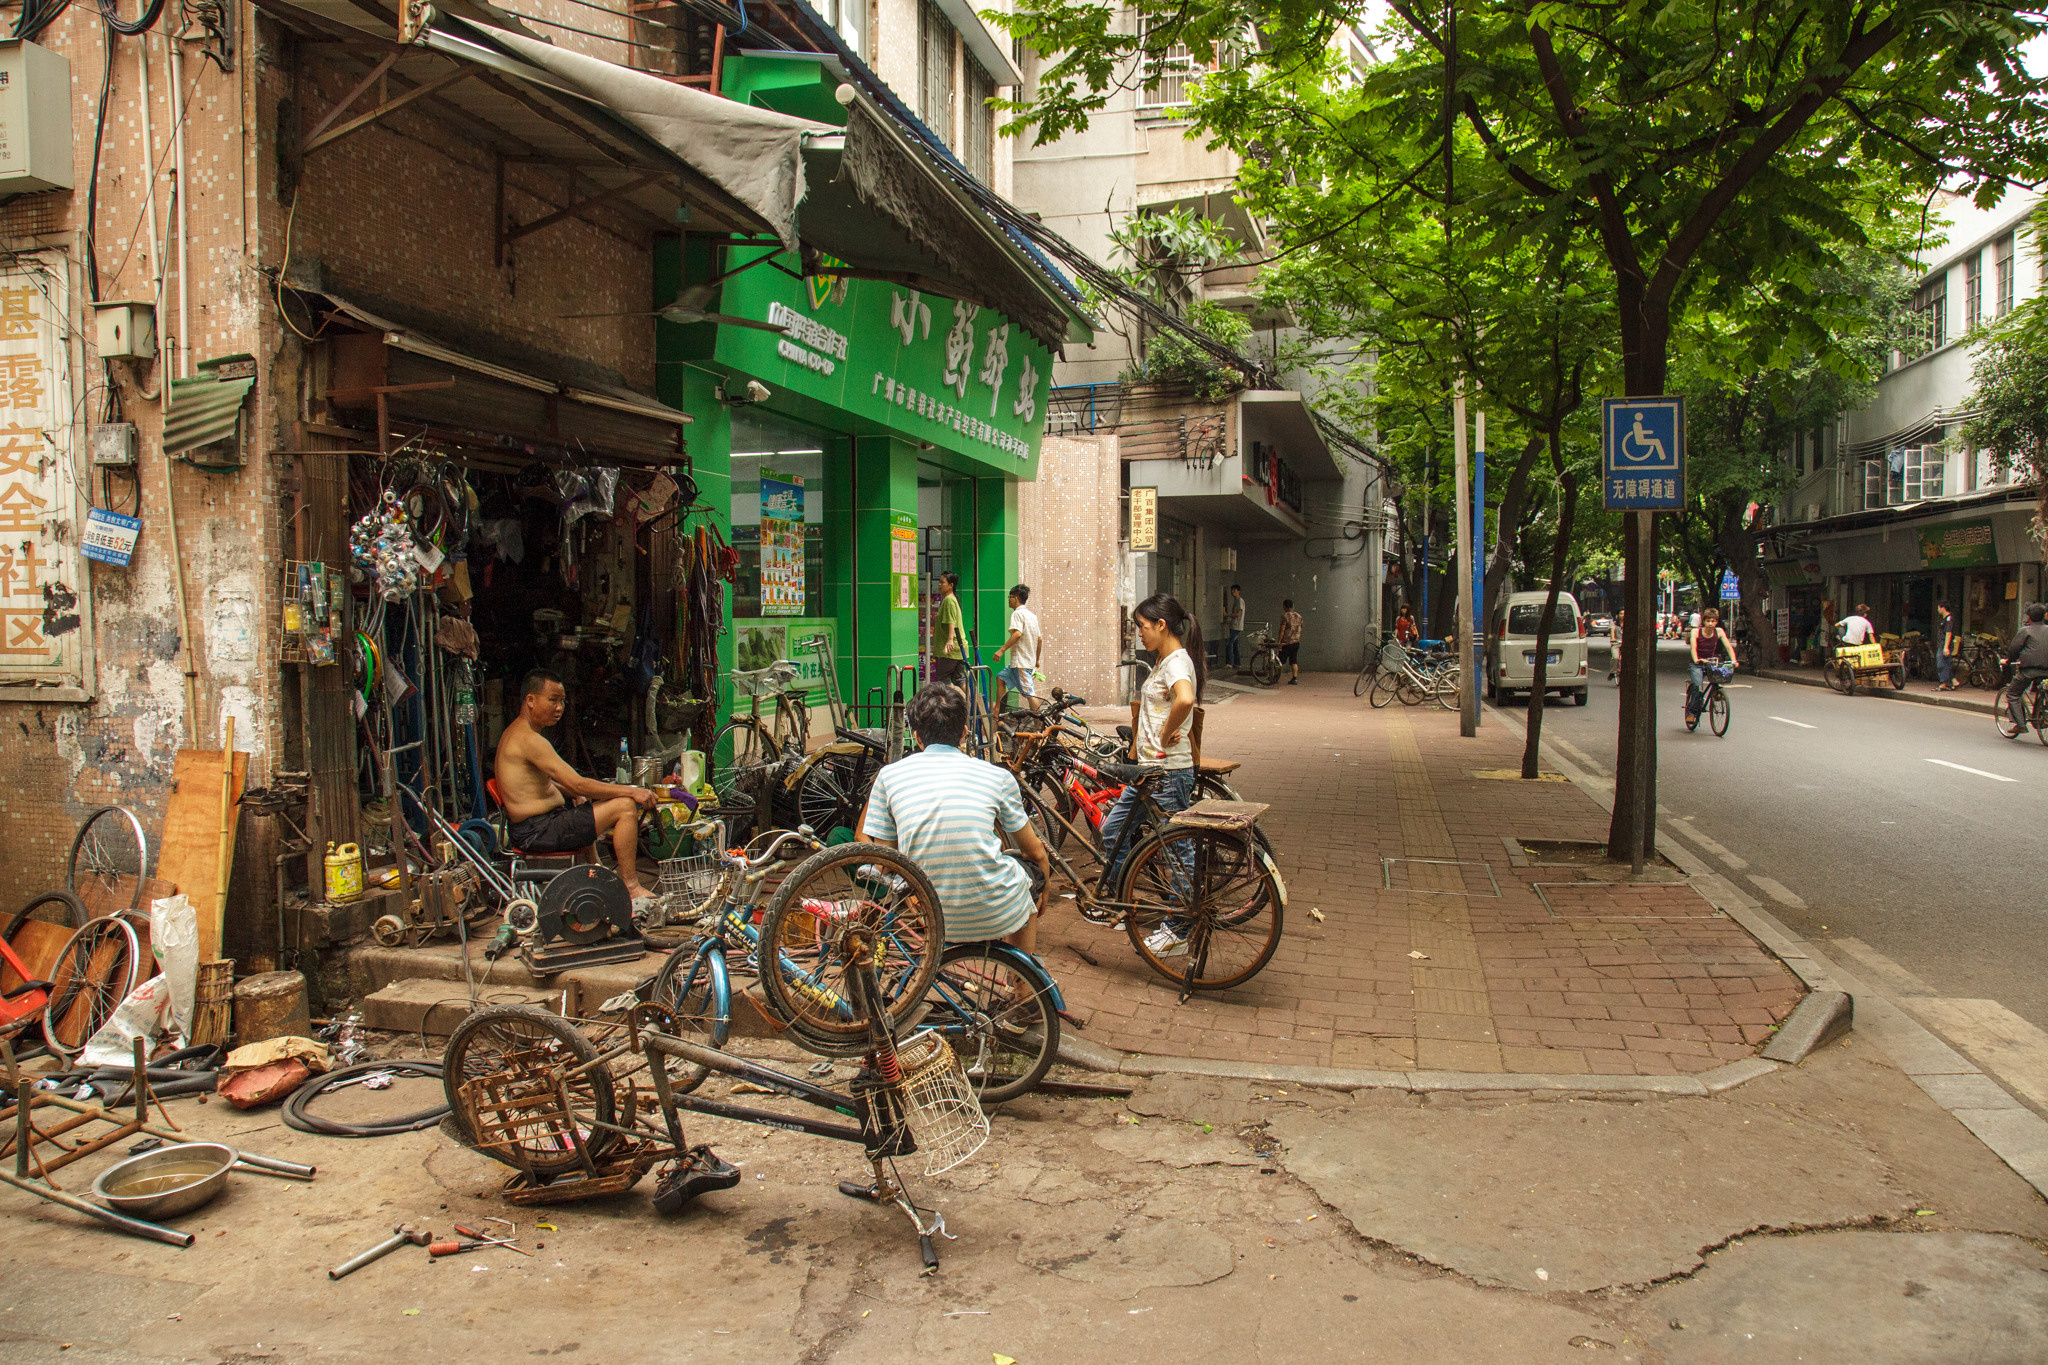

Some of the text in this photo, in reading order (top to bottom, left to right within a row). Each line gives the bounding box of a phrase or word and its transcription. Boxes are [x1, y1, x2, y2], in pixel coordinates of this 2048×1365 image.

[1144, 489, 1154, 544] 广百集团公司
[1612, 478, 1676, 500] 无障碍通道
[1132, 489, 1143, 545] 老干部管理中心
